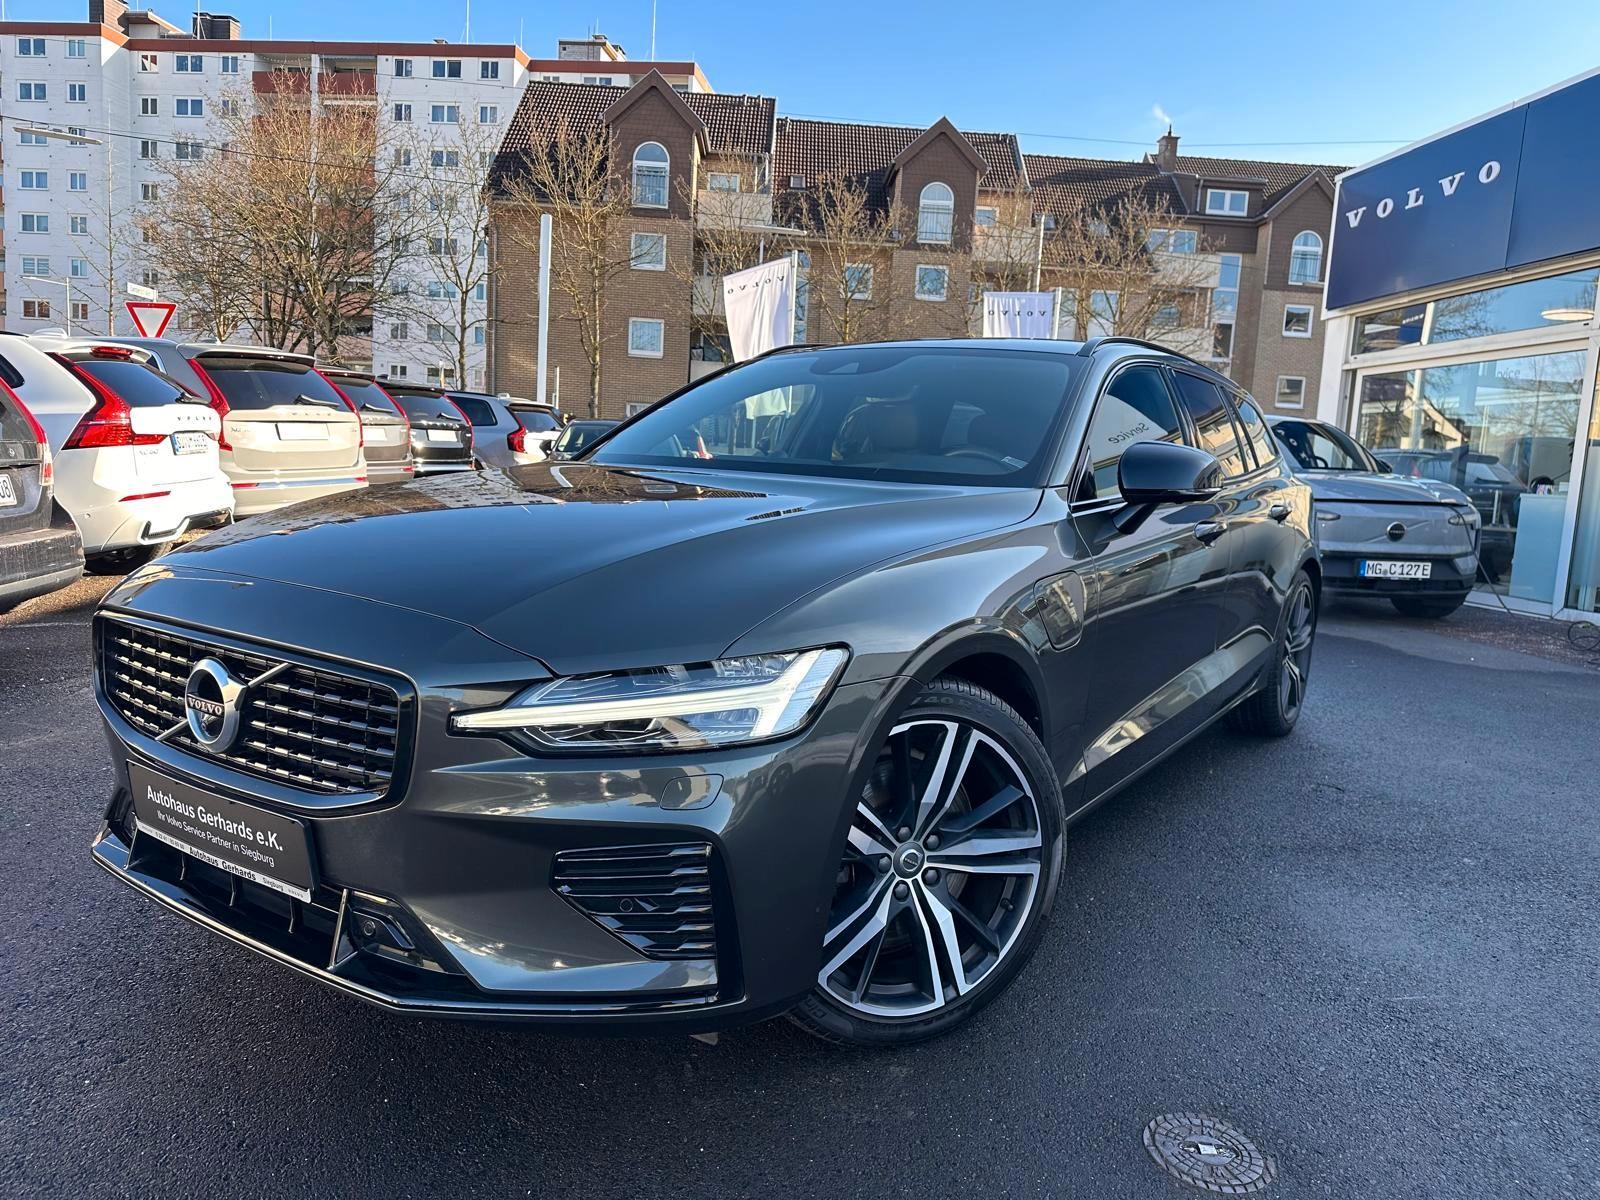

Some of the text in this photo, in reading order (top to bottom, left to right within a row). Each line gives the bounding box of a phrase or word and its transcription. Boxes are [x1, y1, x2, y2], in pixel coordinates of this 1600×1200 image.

[1346, 161, 1501, 228] VOLVO
[1366, 563, 1382, 575] MG
[188, 697, 222, 716] VOLVO
[147, 785, 196, 819] Autohaus
[197, 806, 254, 842] Gerhards
[256, 830, 284, 852] e.K.
[157, 809, 166, 822] Ihr
[166, 812, 183, 830] Volvo
[183, 820, 207, 841] Service
[207, 831, 232, 850] Partner
[232, 841, 240, 852] in
[240, 843, 275, 868] Siegburg
[189, 846, 219, 867] Autohaus
[221, 860, 257, 882] Gerhards
